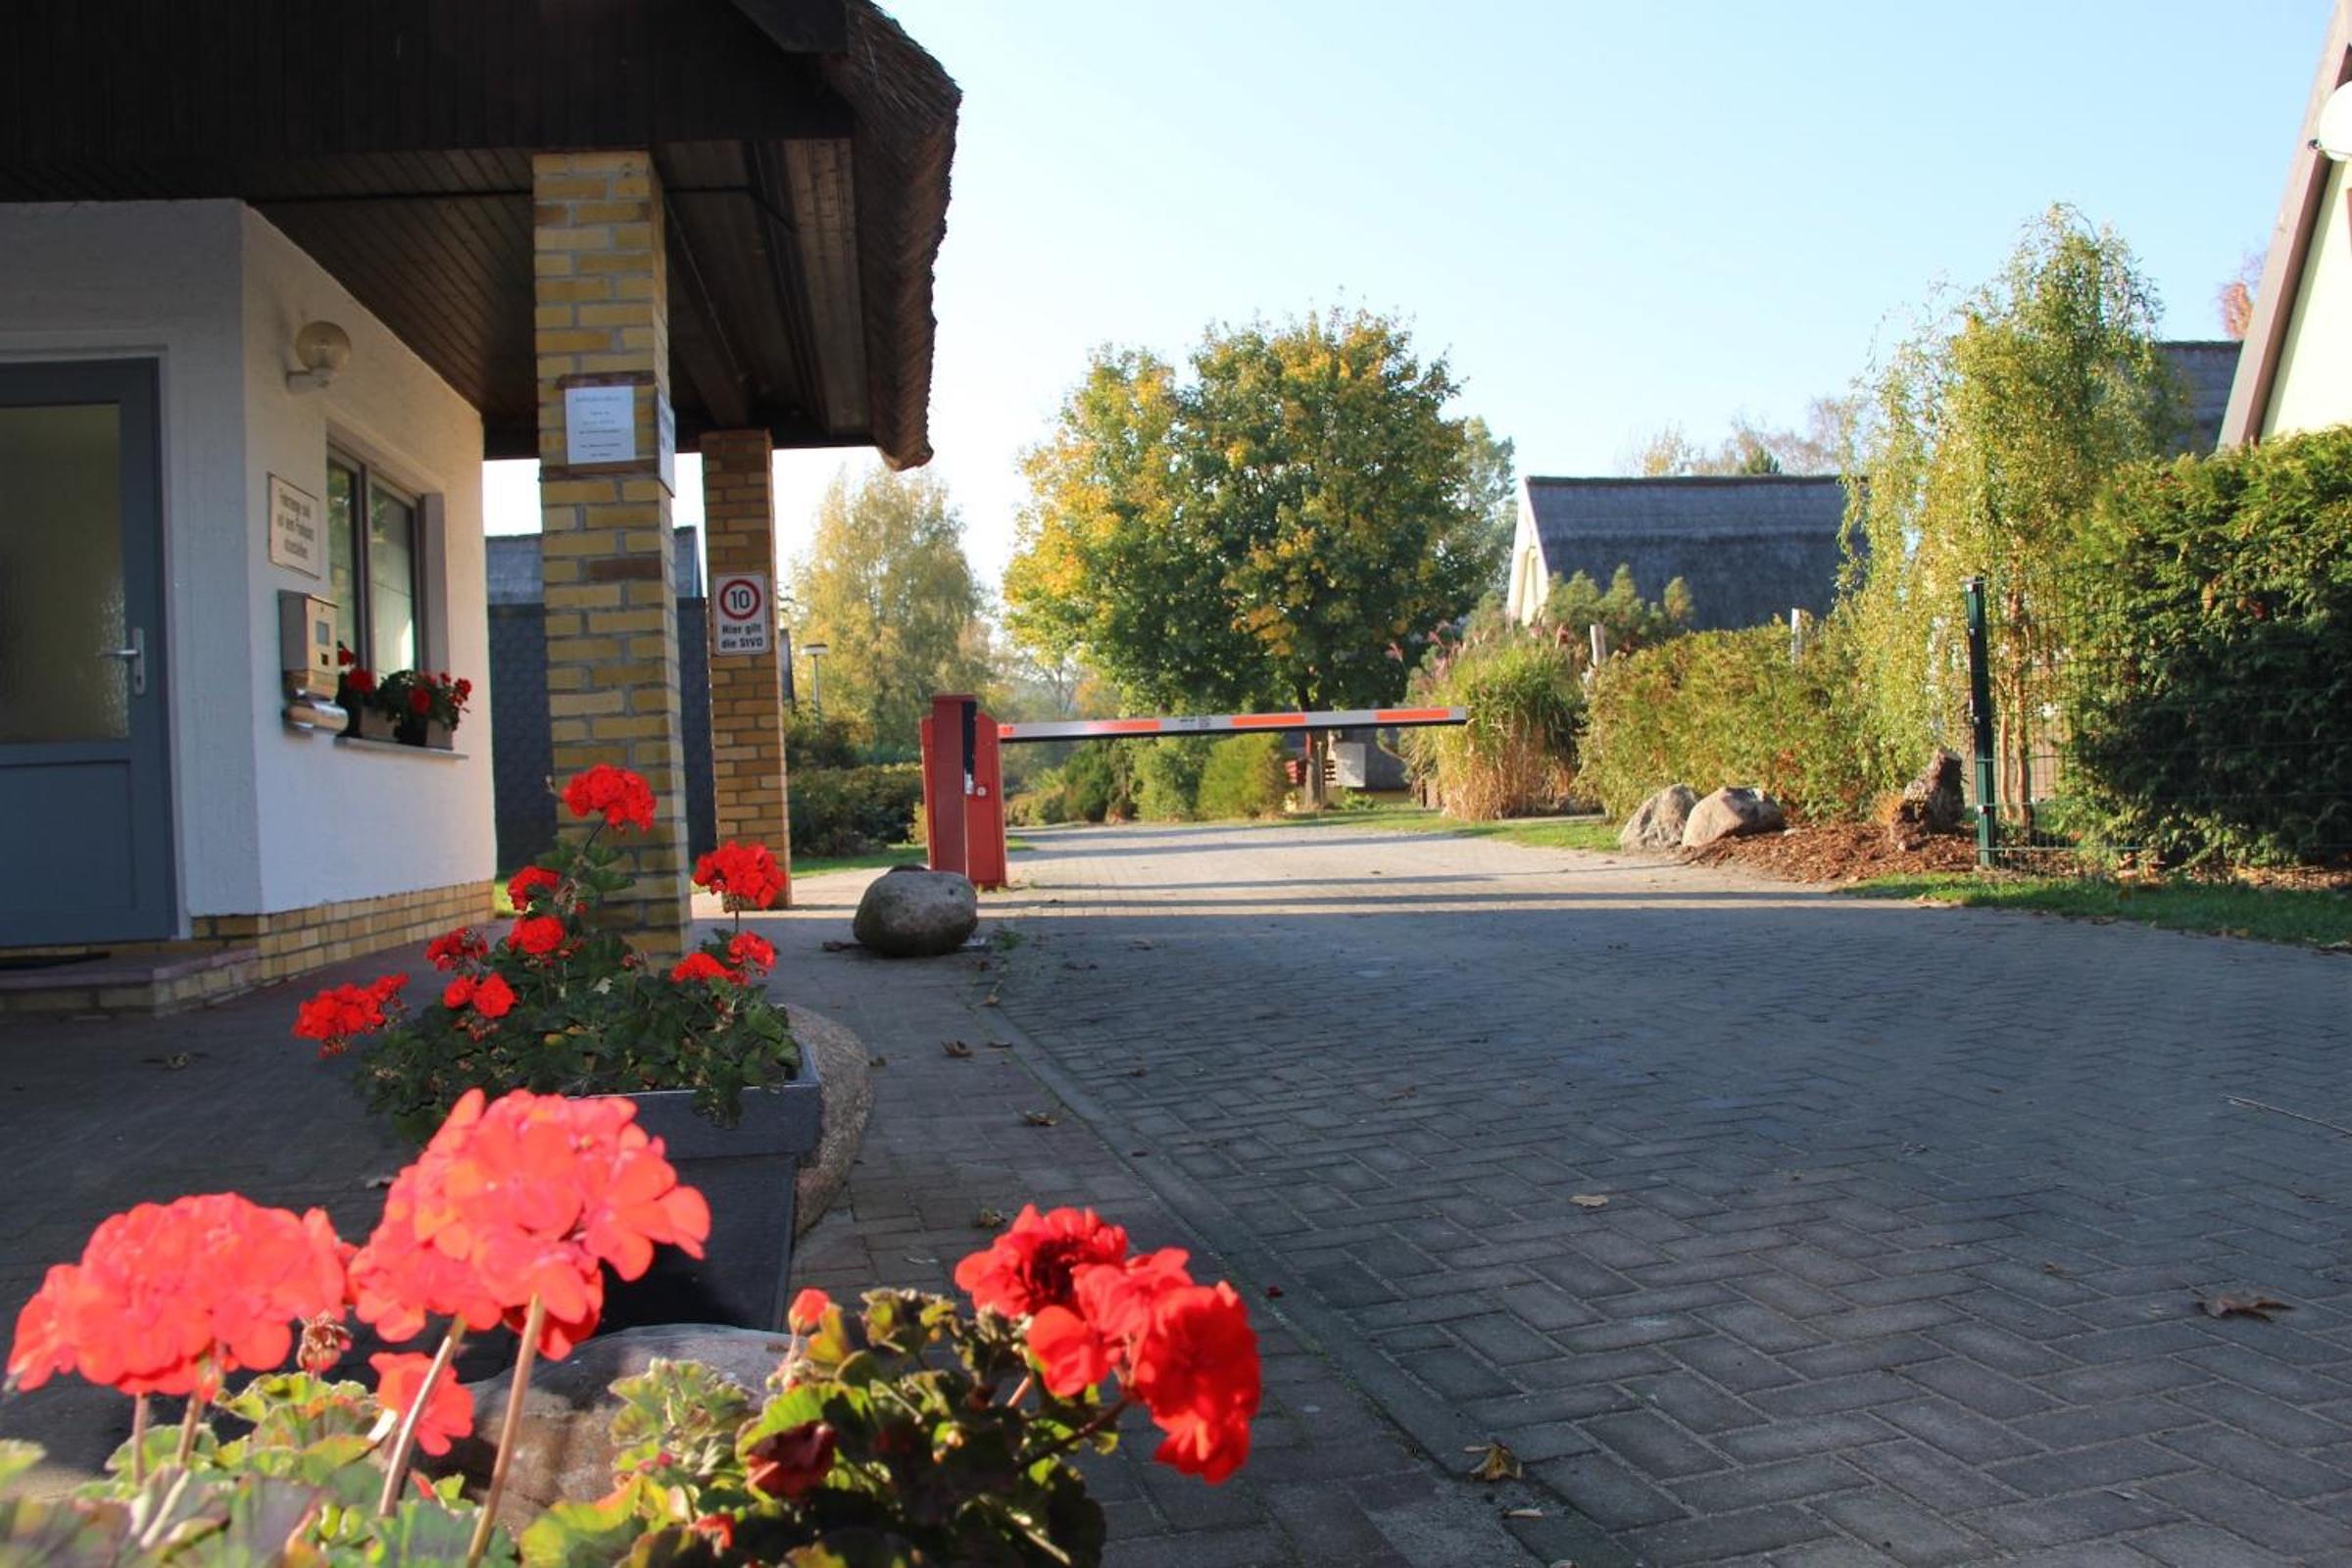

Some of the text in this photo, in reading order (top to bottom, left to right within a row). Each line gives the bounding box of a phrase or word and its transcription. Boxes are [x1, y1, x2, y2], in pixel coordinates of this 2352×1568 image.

[730, 590, 751, 610] 10
[721, 623, 761, 635] Hier gilt
[721, 639, 737, 649] die
